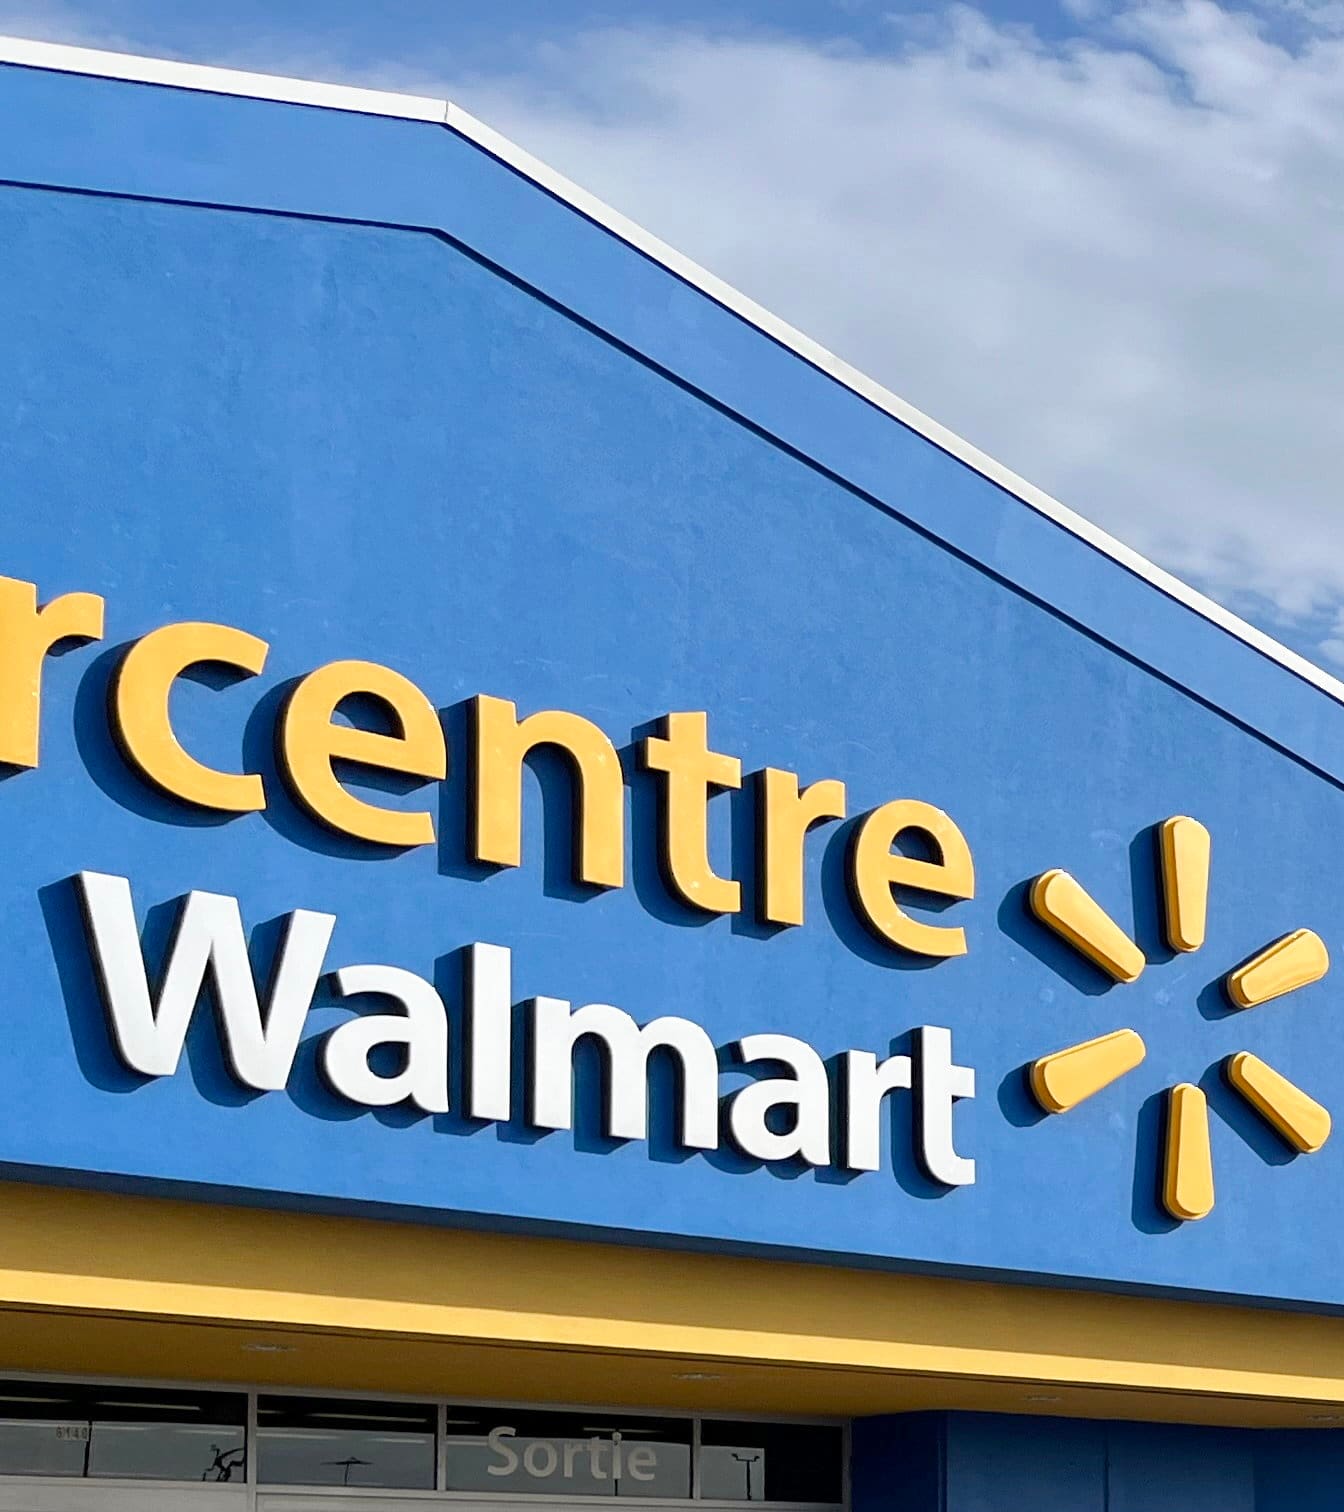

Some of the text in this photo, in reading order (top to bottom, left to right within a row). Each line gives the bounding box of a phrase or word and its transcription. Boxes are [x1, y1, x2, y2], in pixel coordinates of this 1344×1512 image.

[0, 577, 975, 958] rcentre
[78, 870, 975, 1186] Walmart
[486, 1426, 658, 1480] Sortie
